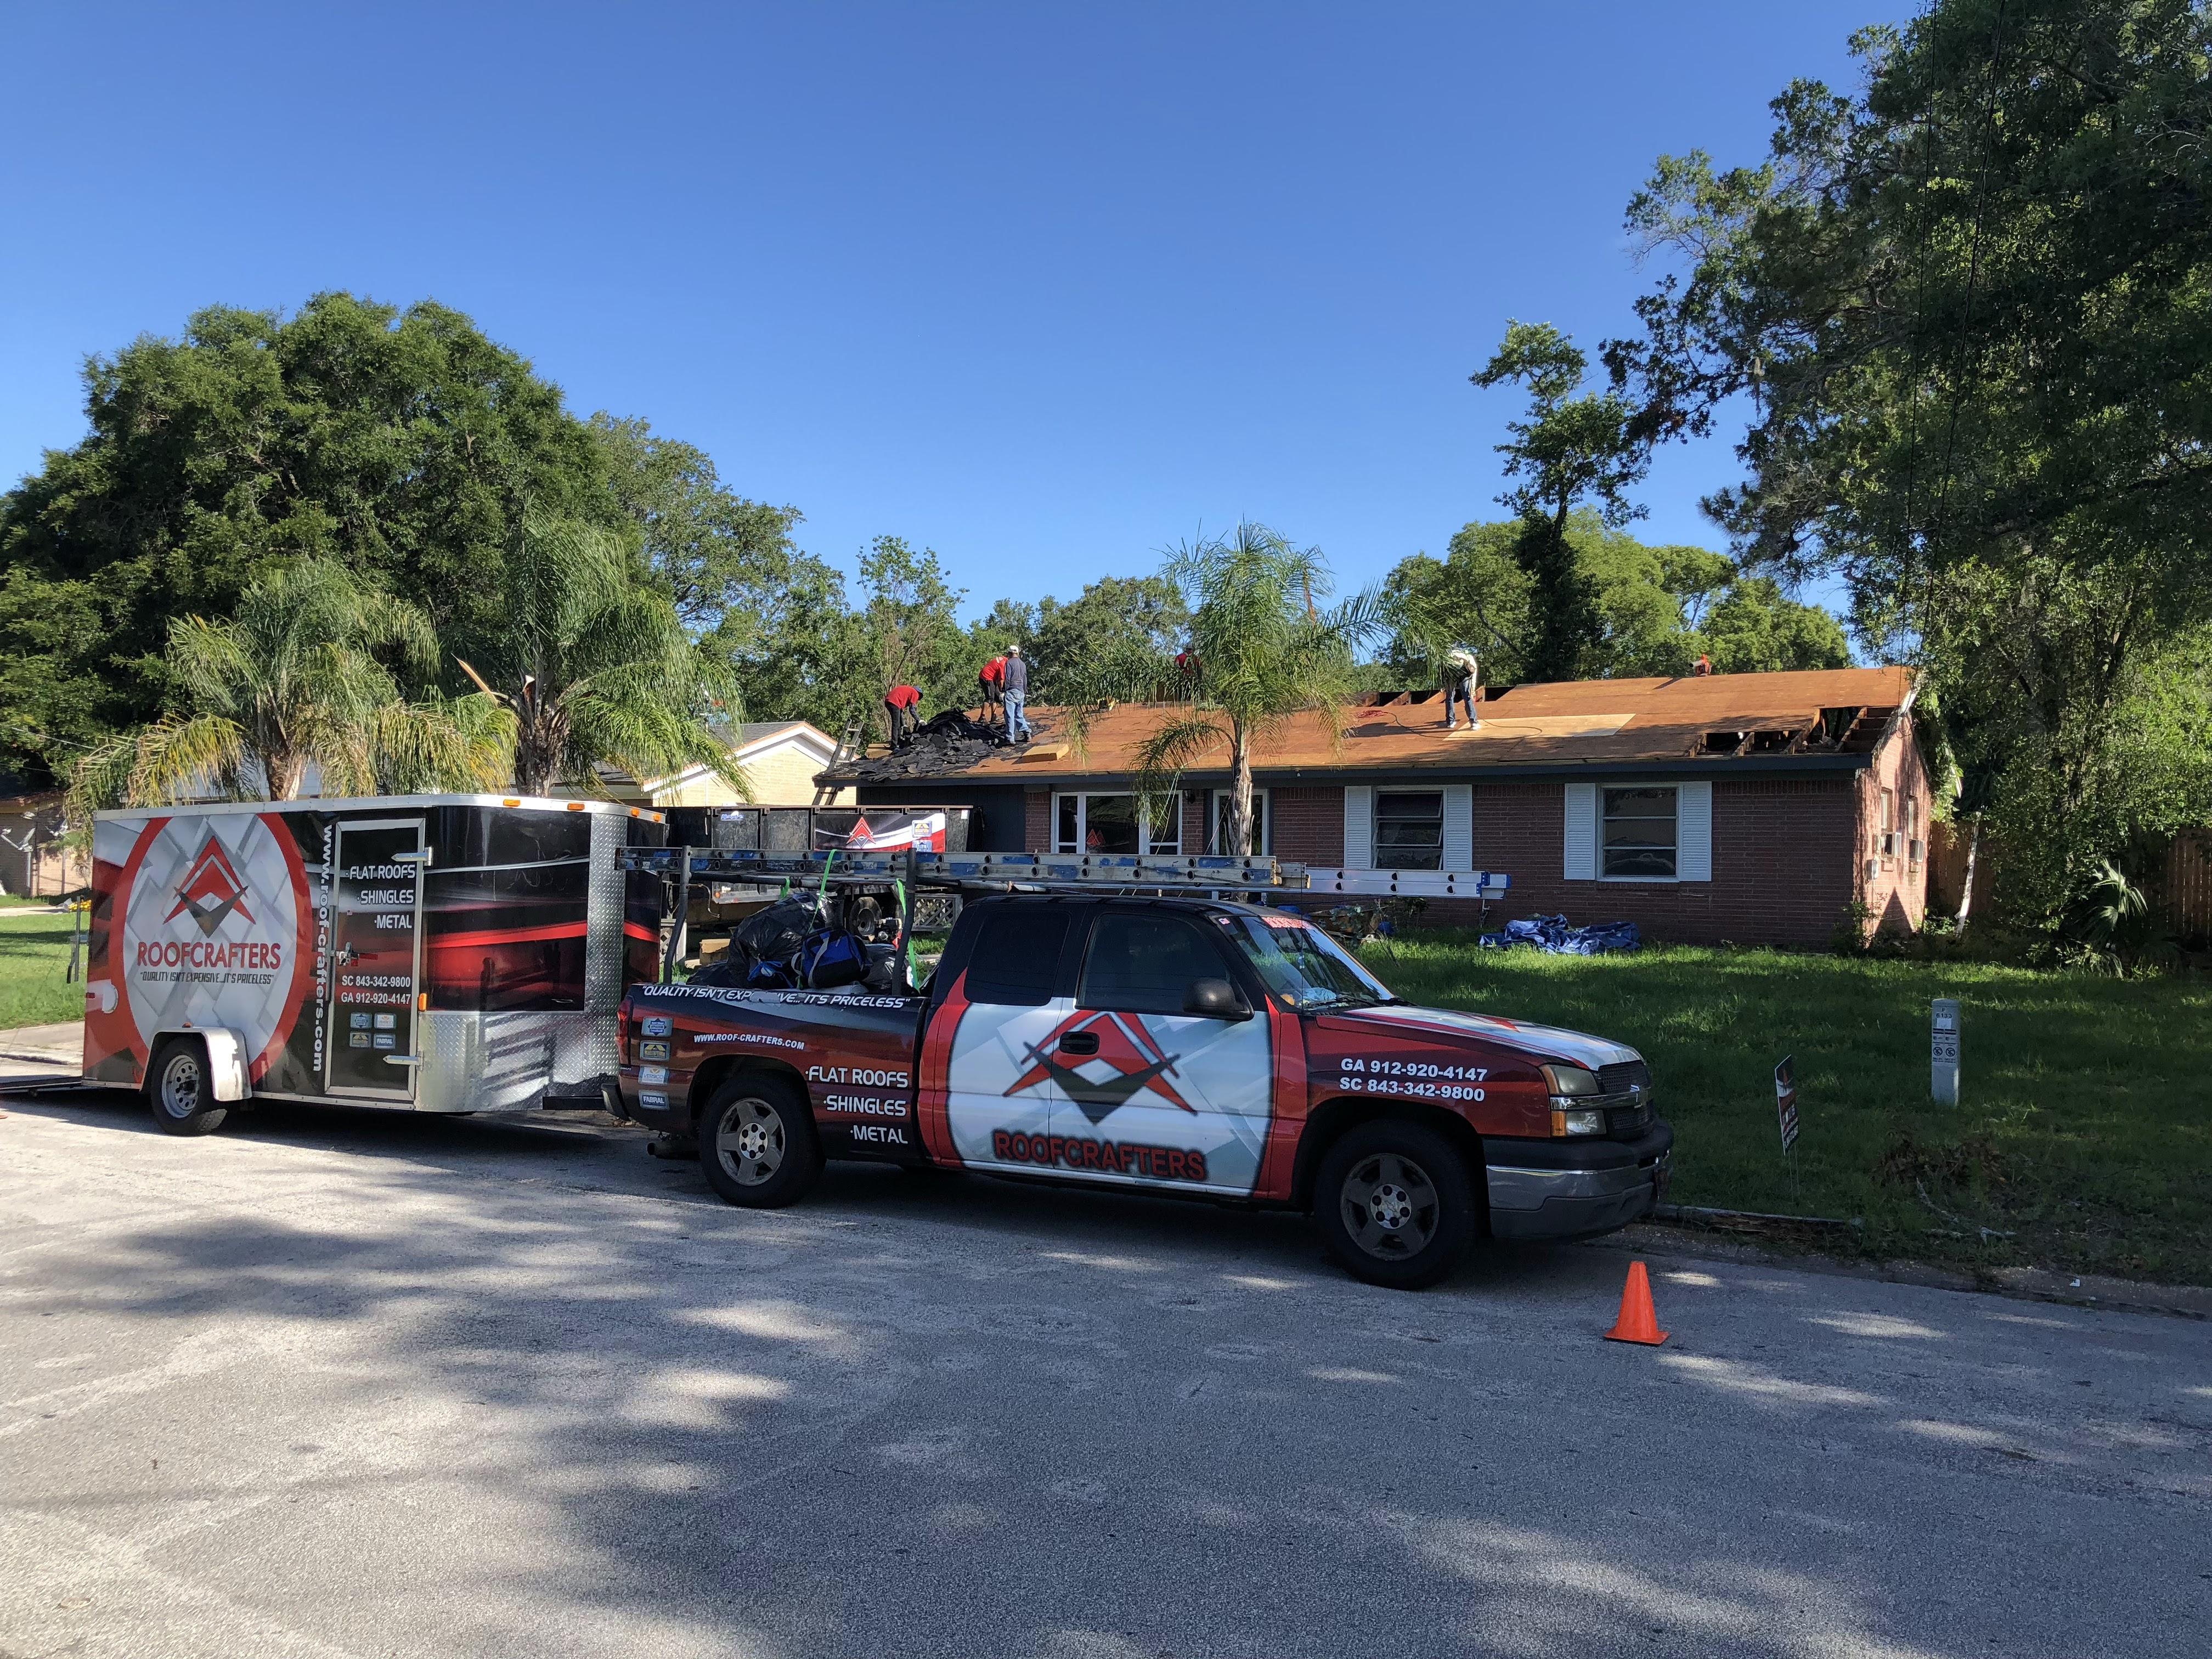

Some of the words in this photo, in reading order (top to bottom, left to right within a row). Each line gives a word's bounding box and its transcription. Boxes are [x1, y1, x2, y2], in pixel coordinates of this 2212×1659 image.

[349, 865, 376, 879] FLAT
[377, 864, 415, 879] ROOFS
[360, 889, 414, 904] SHINGLES
[376, 915, 413, 929] METAL
[137, 941, 281, 970] ROOFCRAFTERS
[313, 824, 332, 1071] www.roof-crafters.com
[341, 975, 354, 986] SC
[356, 975, 411, 988] 843-342-9800
[341, 992, 354, 1003] GA
[356, 992, 411, 1005] 912-920-4147
[692, 988, 727, 999] ISN'T
[804, 994, 830, 1005] IT'S
[694, 1034, 805, 1050] WWW.ROOF-CRAFTERS.COM
[809, 1066, 848, 1083] FLAT
[852, 1068, 909, 1088] ROOFS
[1341, 1058, 1365, 1071] GA
[1370, 1060, 1488, 1081] 912-920-4147
[1339, 1077, 1362, 1091] SC
[1367, 1079, 1485, 1102] 843-342-9800
[643, 1096, 664, 1104] FABRAL
[826, 1095, 906, 1116] SHINGLES
[853, 1125, 909, 1144] METAL
[994, 1132, 1206, 1181] ROOFCRAFTERS
